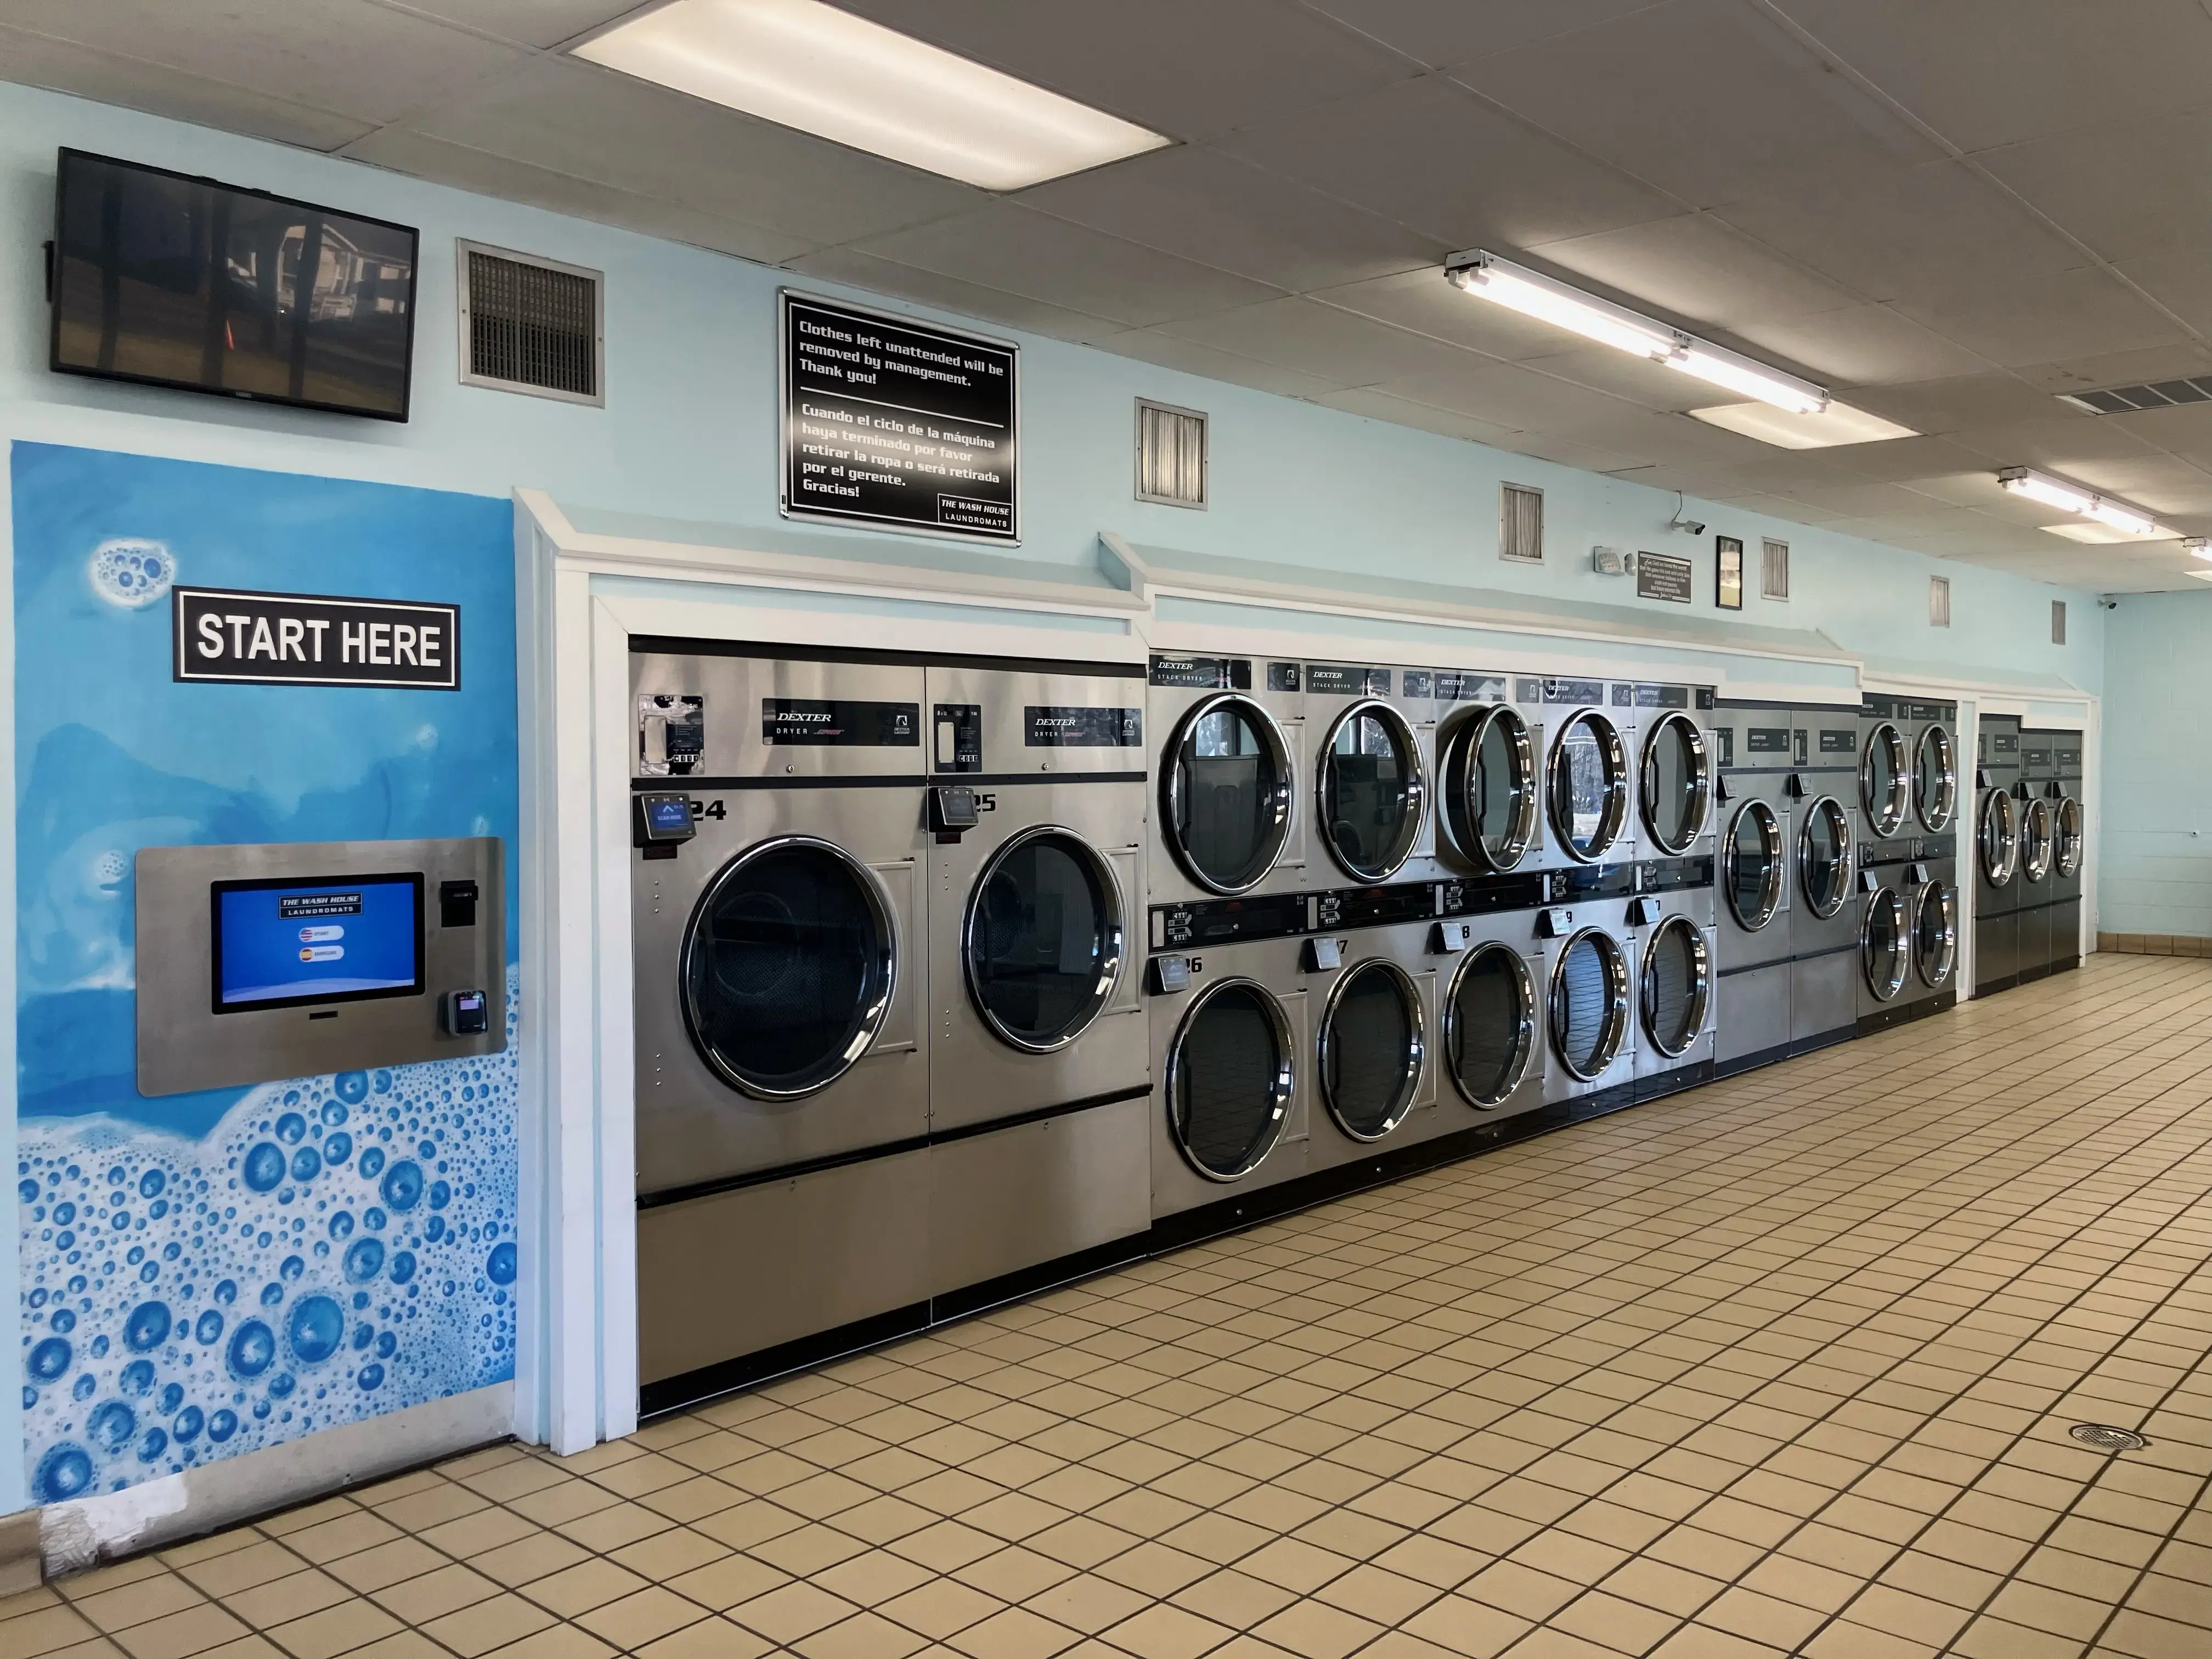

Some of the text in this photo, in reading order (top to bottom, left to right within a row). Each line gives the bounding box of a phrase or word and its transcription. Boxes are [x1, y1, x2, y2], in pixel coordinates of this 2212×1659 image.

[800, 320, 1003, 376] Clothes left unattended will be
[800, 342, 971, 386] removed by management.
[800, 358, 876, 385] Thank you!
[802, 403, 995, 449] Cuando el ciclo de la máquina
[802, 422, 972, 462] haya terminado por favor
[803, 443, 1000, 483] retirar la ropa o será retirada
[803, 462, 906, 486] por el gerente.
[803, 478, 860, 497] Gracias!
[941, 499, 1009, 516] THE WASH HOUSE
[945, 513, 1007, 527] LAUNDROMATS
[198, 613, 441, 667] START HERE
[1158, 662, 1193, 670] DEXTER
[777, 713, 831, 721] DEXTER
[690, 800, 726, 821] 24
[288, 906, 353, 916] LAUNDROMATS
[1338, 940, 1348, 955] 7
